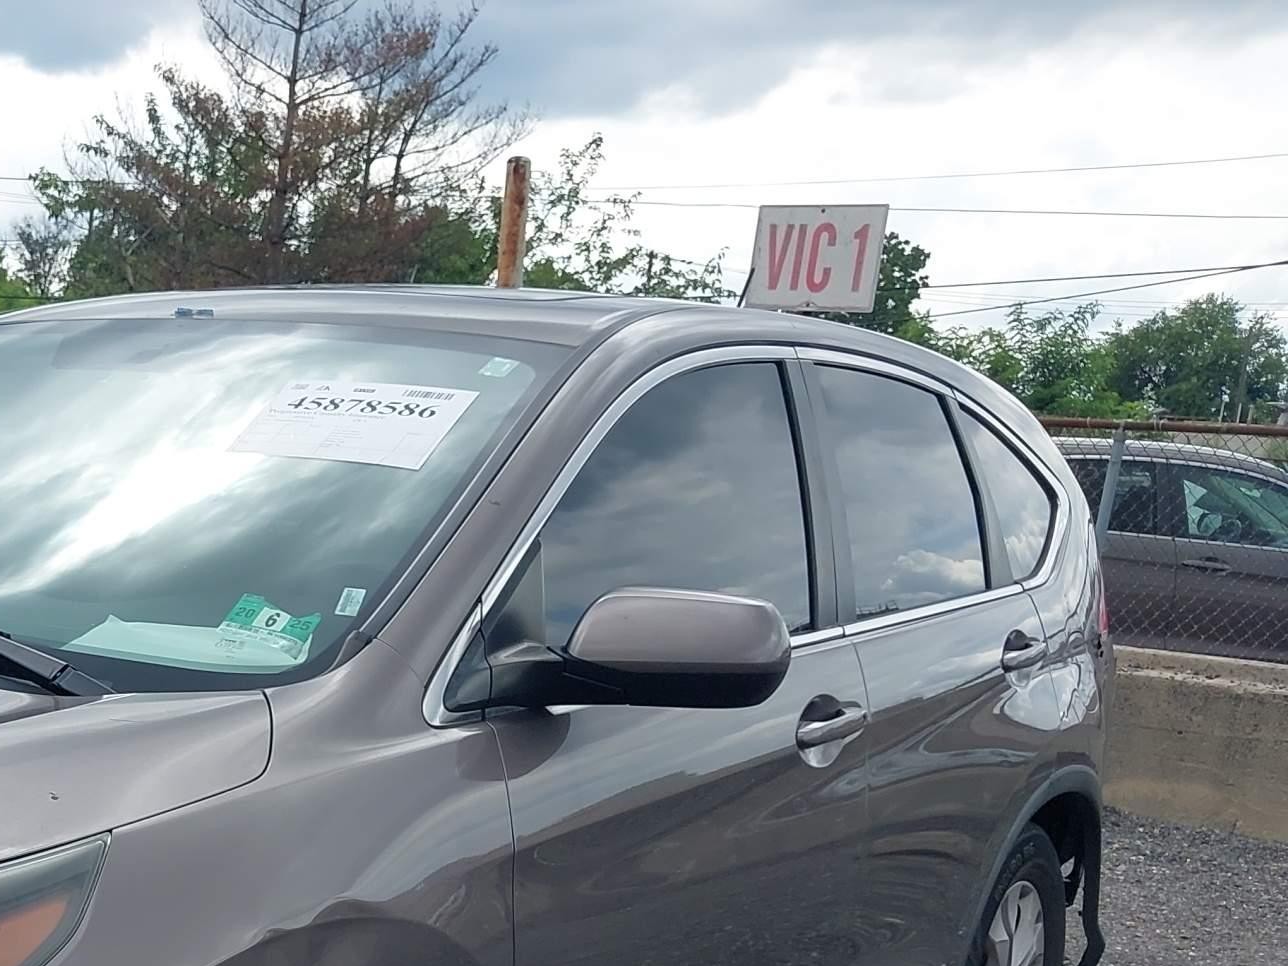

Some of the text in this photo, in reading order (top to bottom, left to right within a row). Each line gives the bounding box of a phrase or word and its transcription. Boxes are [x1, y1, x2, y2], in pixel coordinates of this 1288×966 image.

[768, 223, 871, 292] VIC 1
[287, 396, 440, 418] 45878586
[235, 606, 313, 631] 20 6 25
